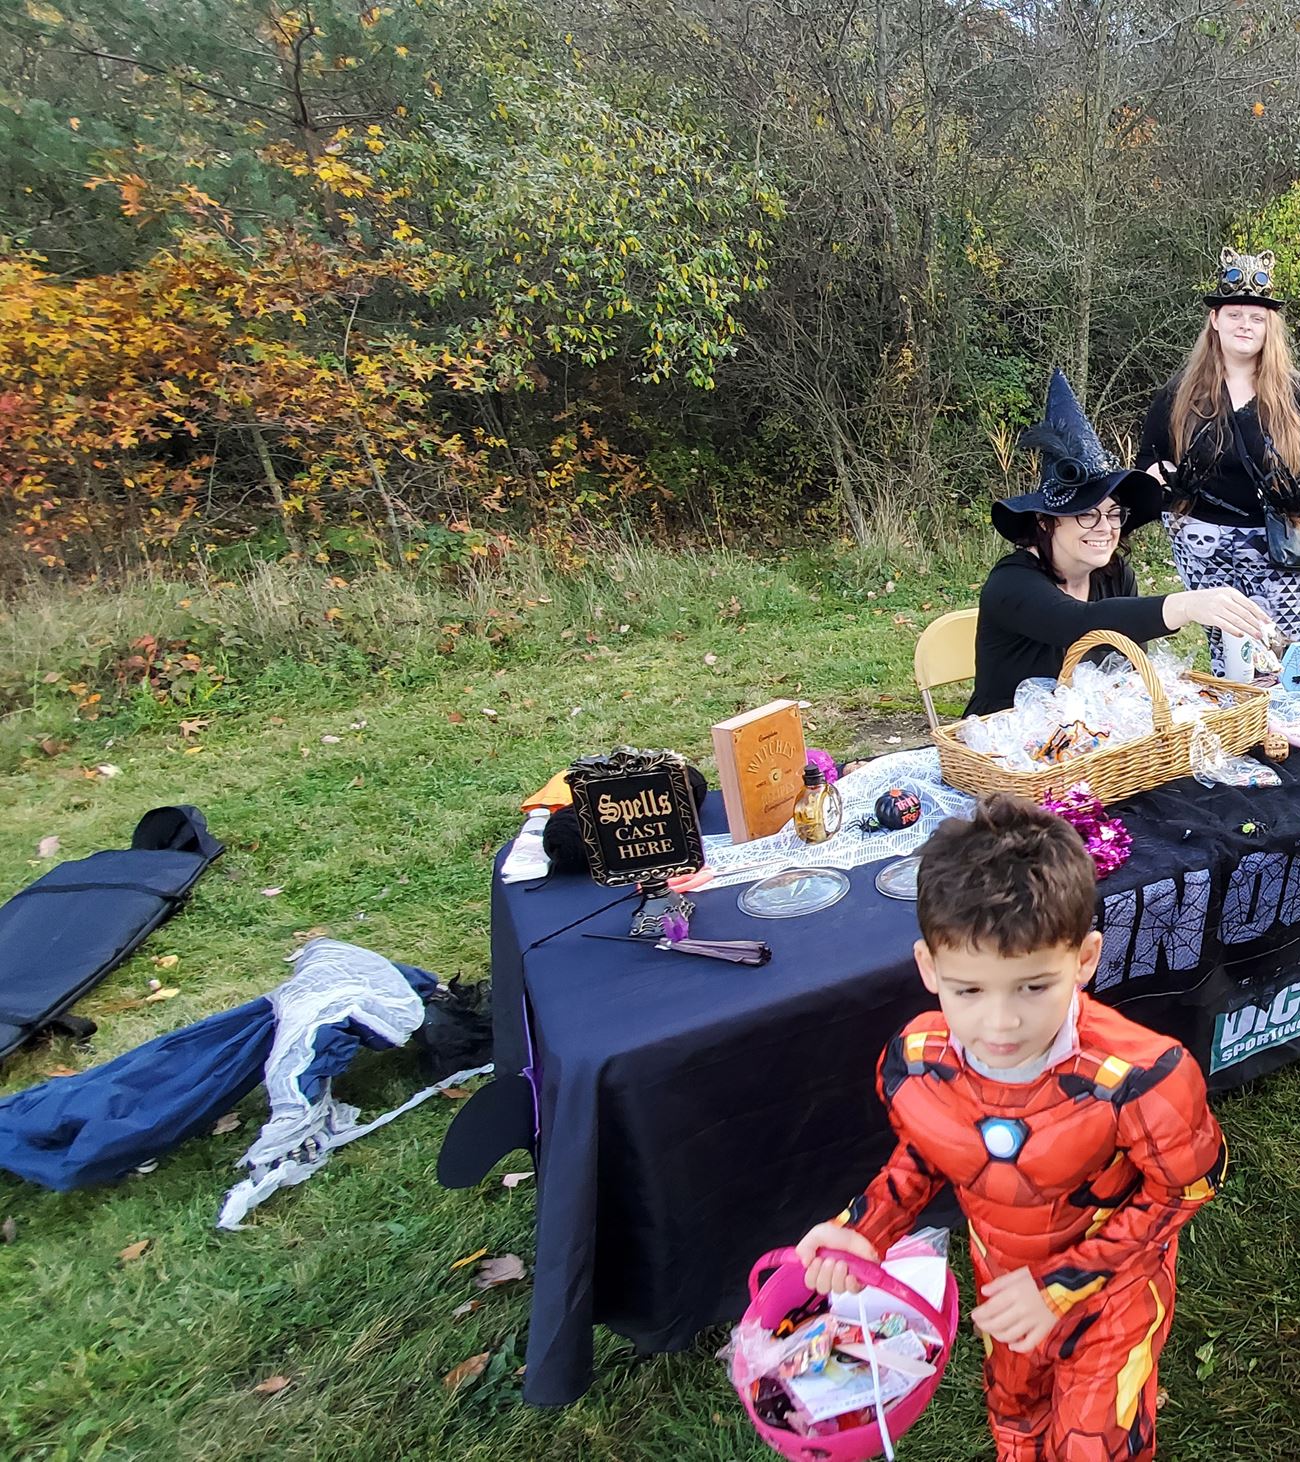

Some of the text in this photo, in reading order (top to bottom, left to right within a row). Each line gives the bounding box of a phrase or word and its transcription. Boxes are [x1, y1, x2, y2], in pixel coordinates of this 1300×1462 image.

[747, 739, 796, 775] WITCHES
[597, 789, 672, 825] Spells
[615, 821, 667, 841] CAST
[618, 838, 675, 859] HERE
